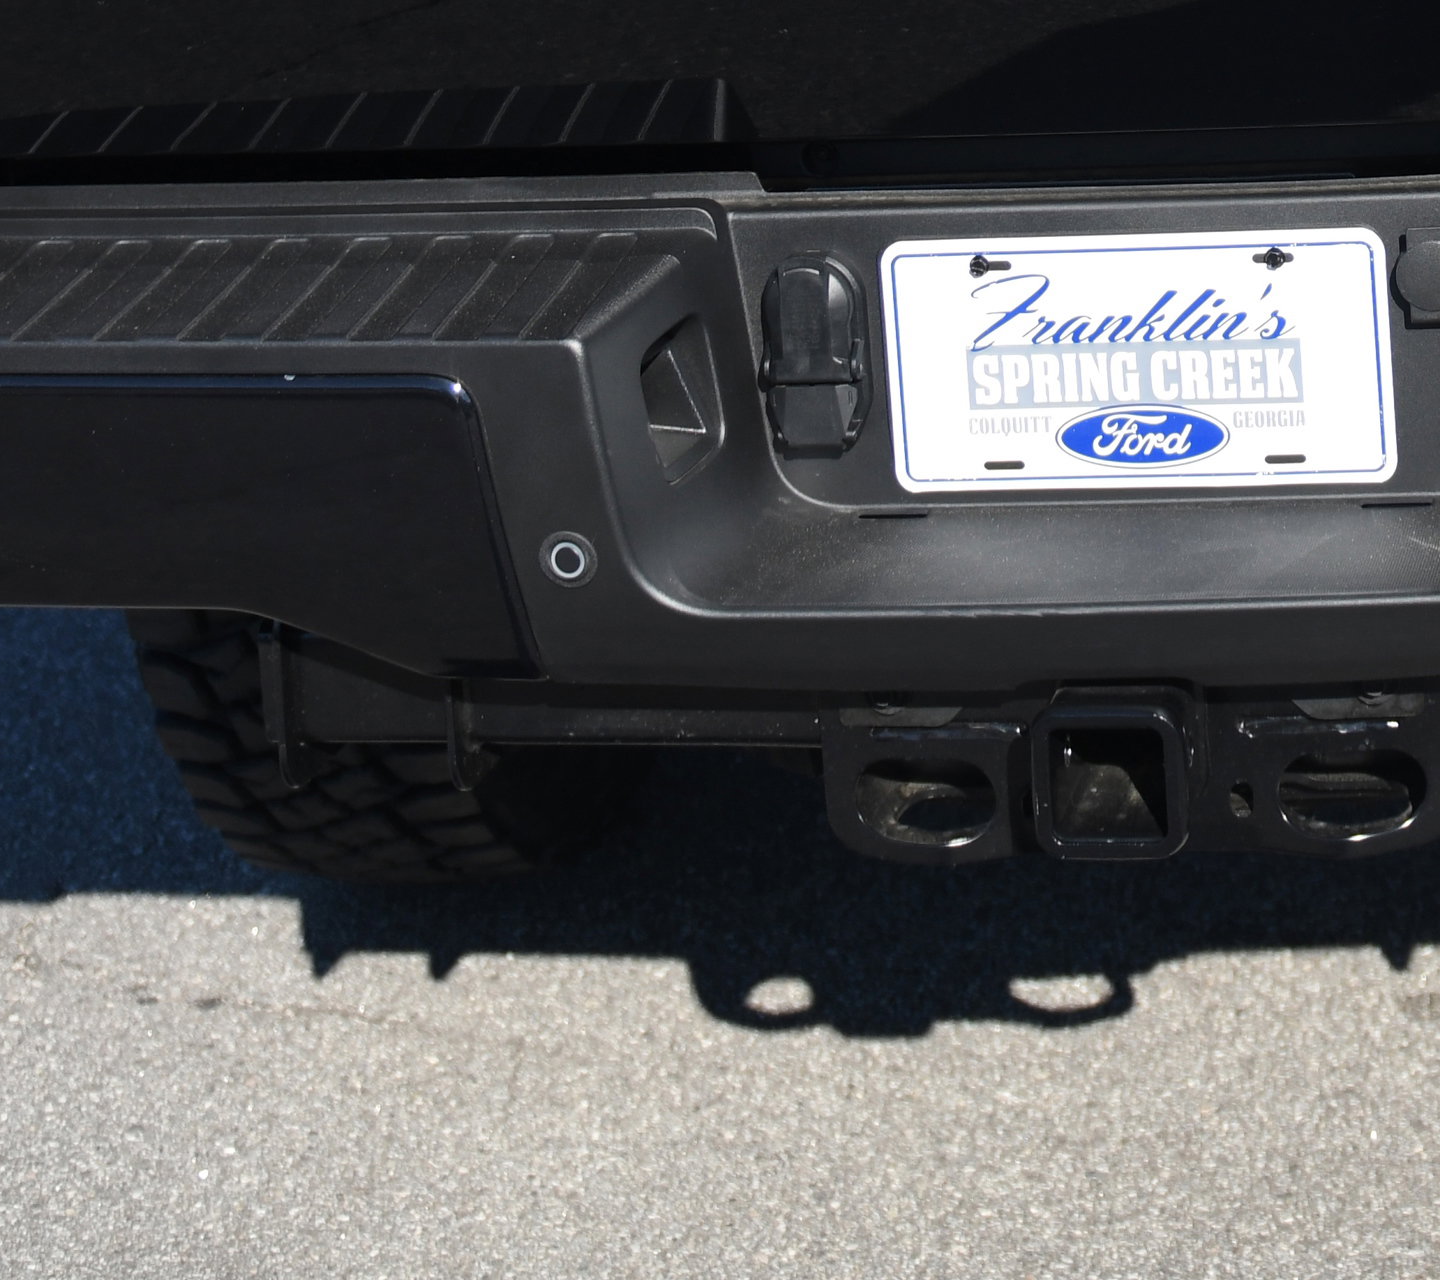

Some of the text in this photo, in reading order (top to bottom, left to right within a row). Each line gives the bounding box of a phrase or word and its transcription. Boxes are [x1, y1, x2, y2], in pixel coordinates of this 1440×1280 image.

[968, 273, 1298, 353] Franklin's
[973, 346, 1300, 405] SPRING CREEK
[968, 413, 1053, 436] COLQUITT
[1092, 413, 1193, 457] Ford
[1232, 408, 1308, 430] GEORGIA
